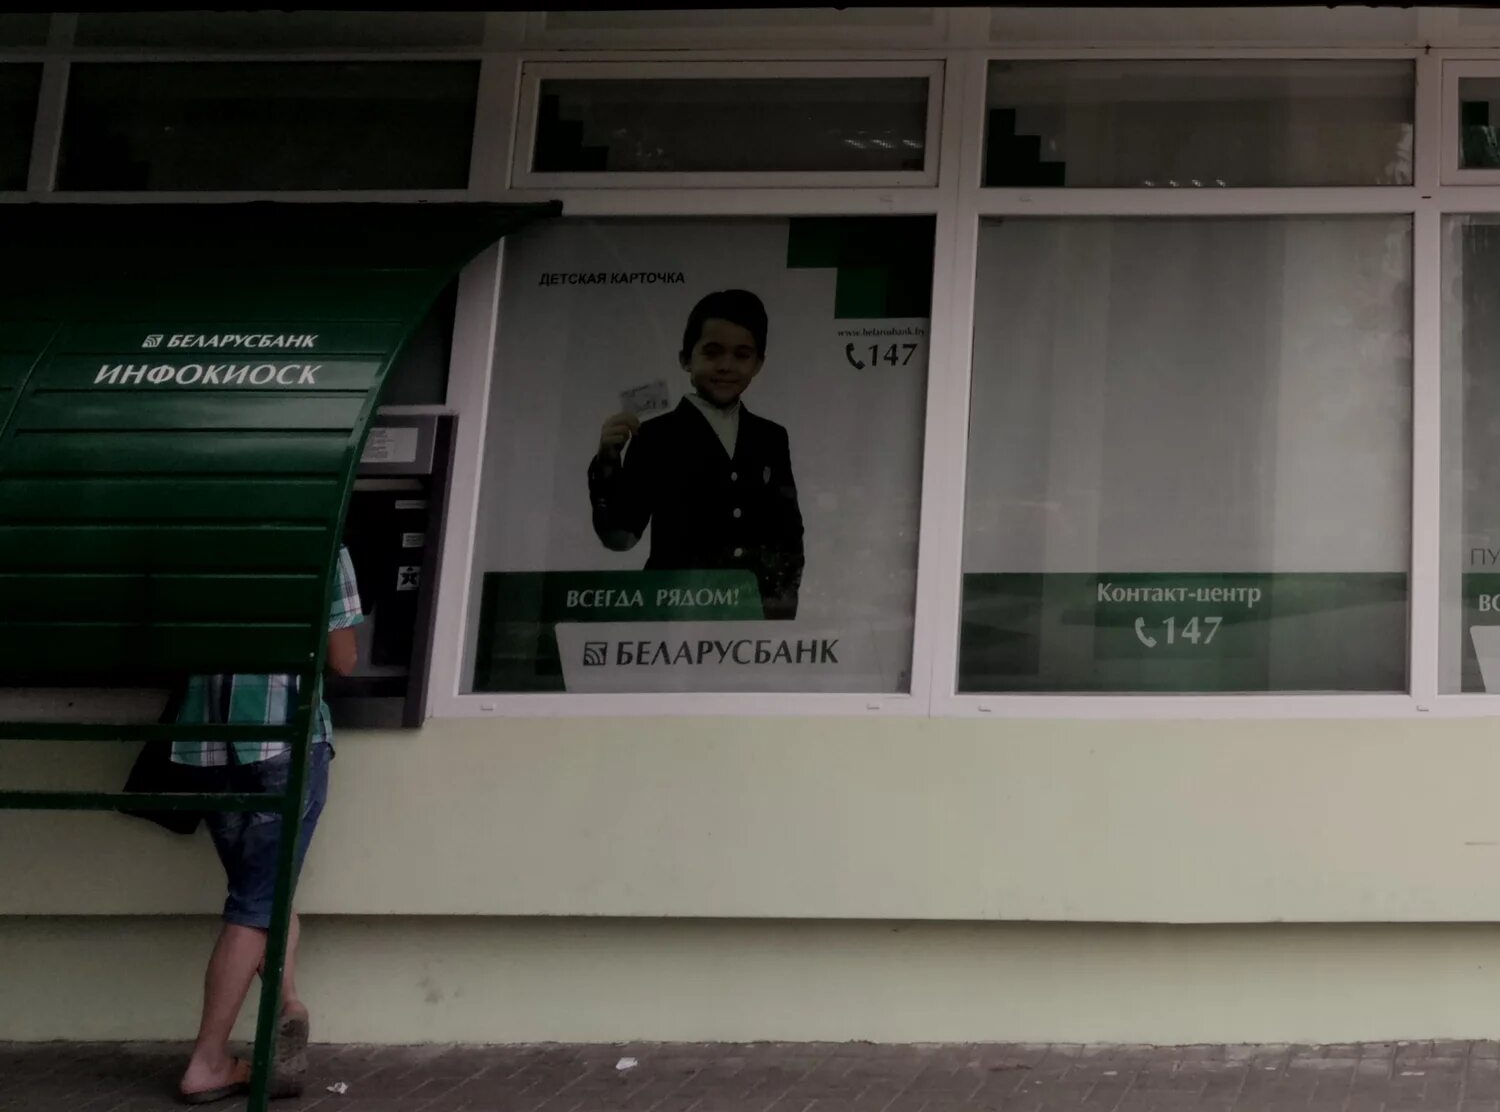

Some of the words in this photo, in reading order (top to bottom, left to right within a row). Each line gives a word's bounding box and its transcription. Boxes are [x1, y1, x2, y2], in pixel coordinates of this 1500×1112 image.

[538, 272, 607, 287] ДЕТСКАЯ
[610, 271, 685, 285] КАРТОЧКА
[167, 334, 318, 348] БЕЛАРУСБАНК
[868, 343, 918, 367] 147
[93, 364, 322, 385] ИНФОКИОСК
[566, 589, 644, 608] ВСЕГДА
[656, 588, 740, 606] РЯДОМ!
[1097, 582, 1262, 609] Контакт-центр
[1162, 616, 1223, 645] 147
[616, 639, 840, 666] БЕЛАРУСБАНК
